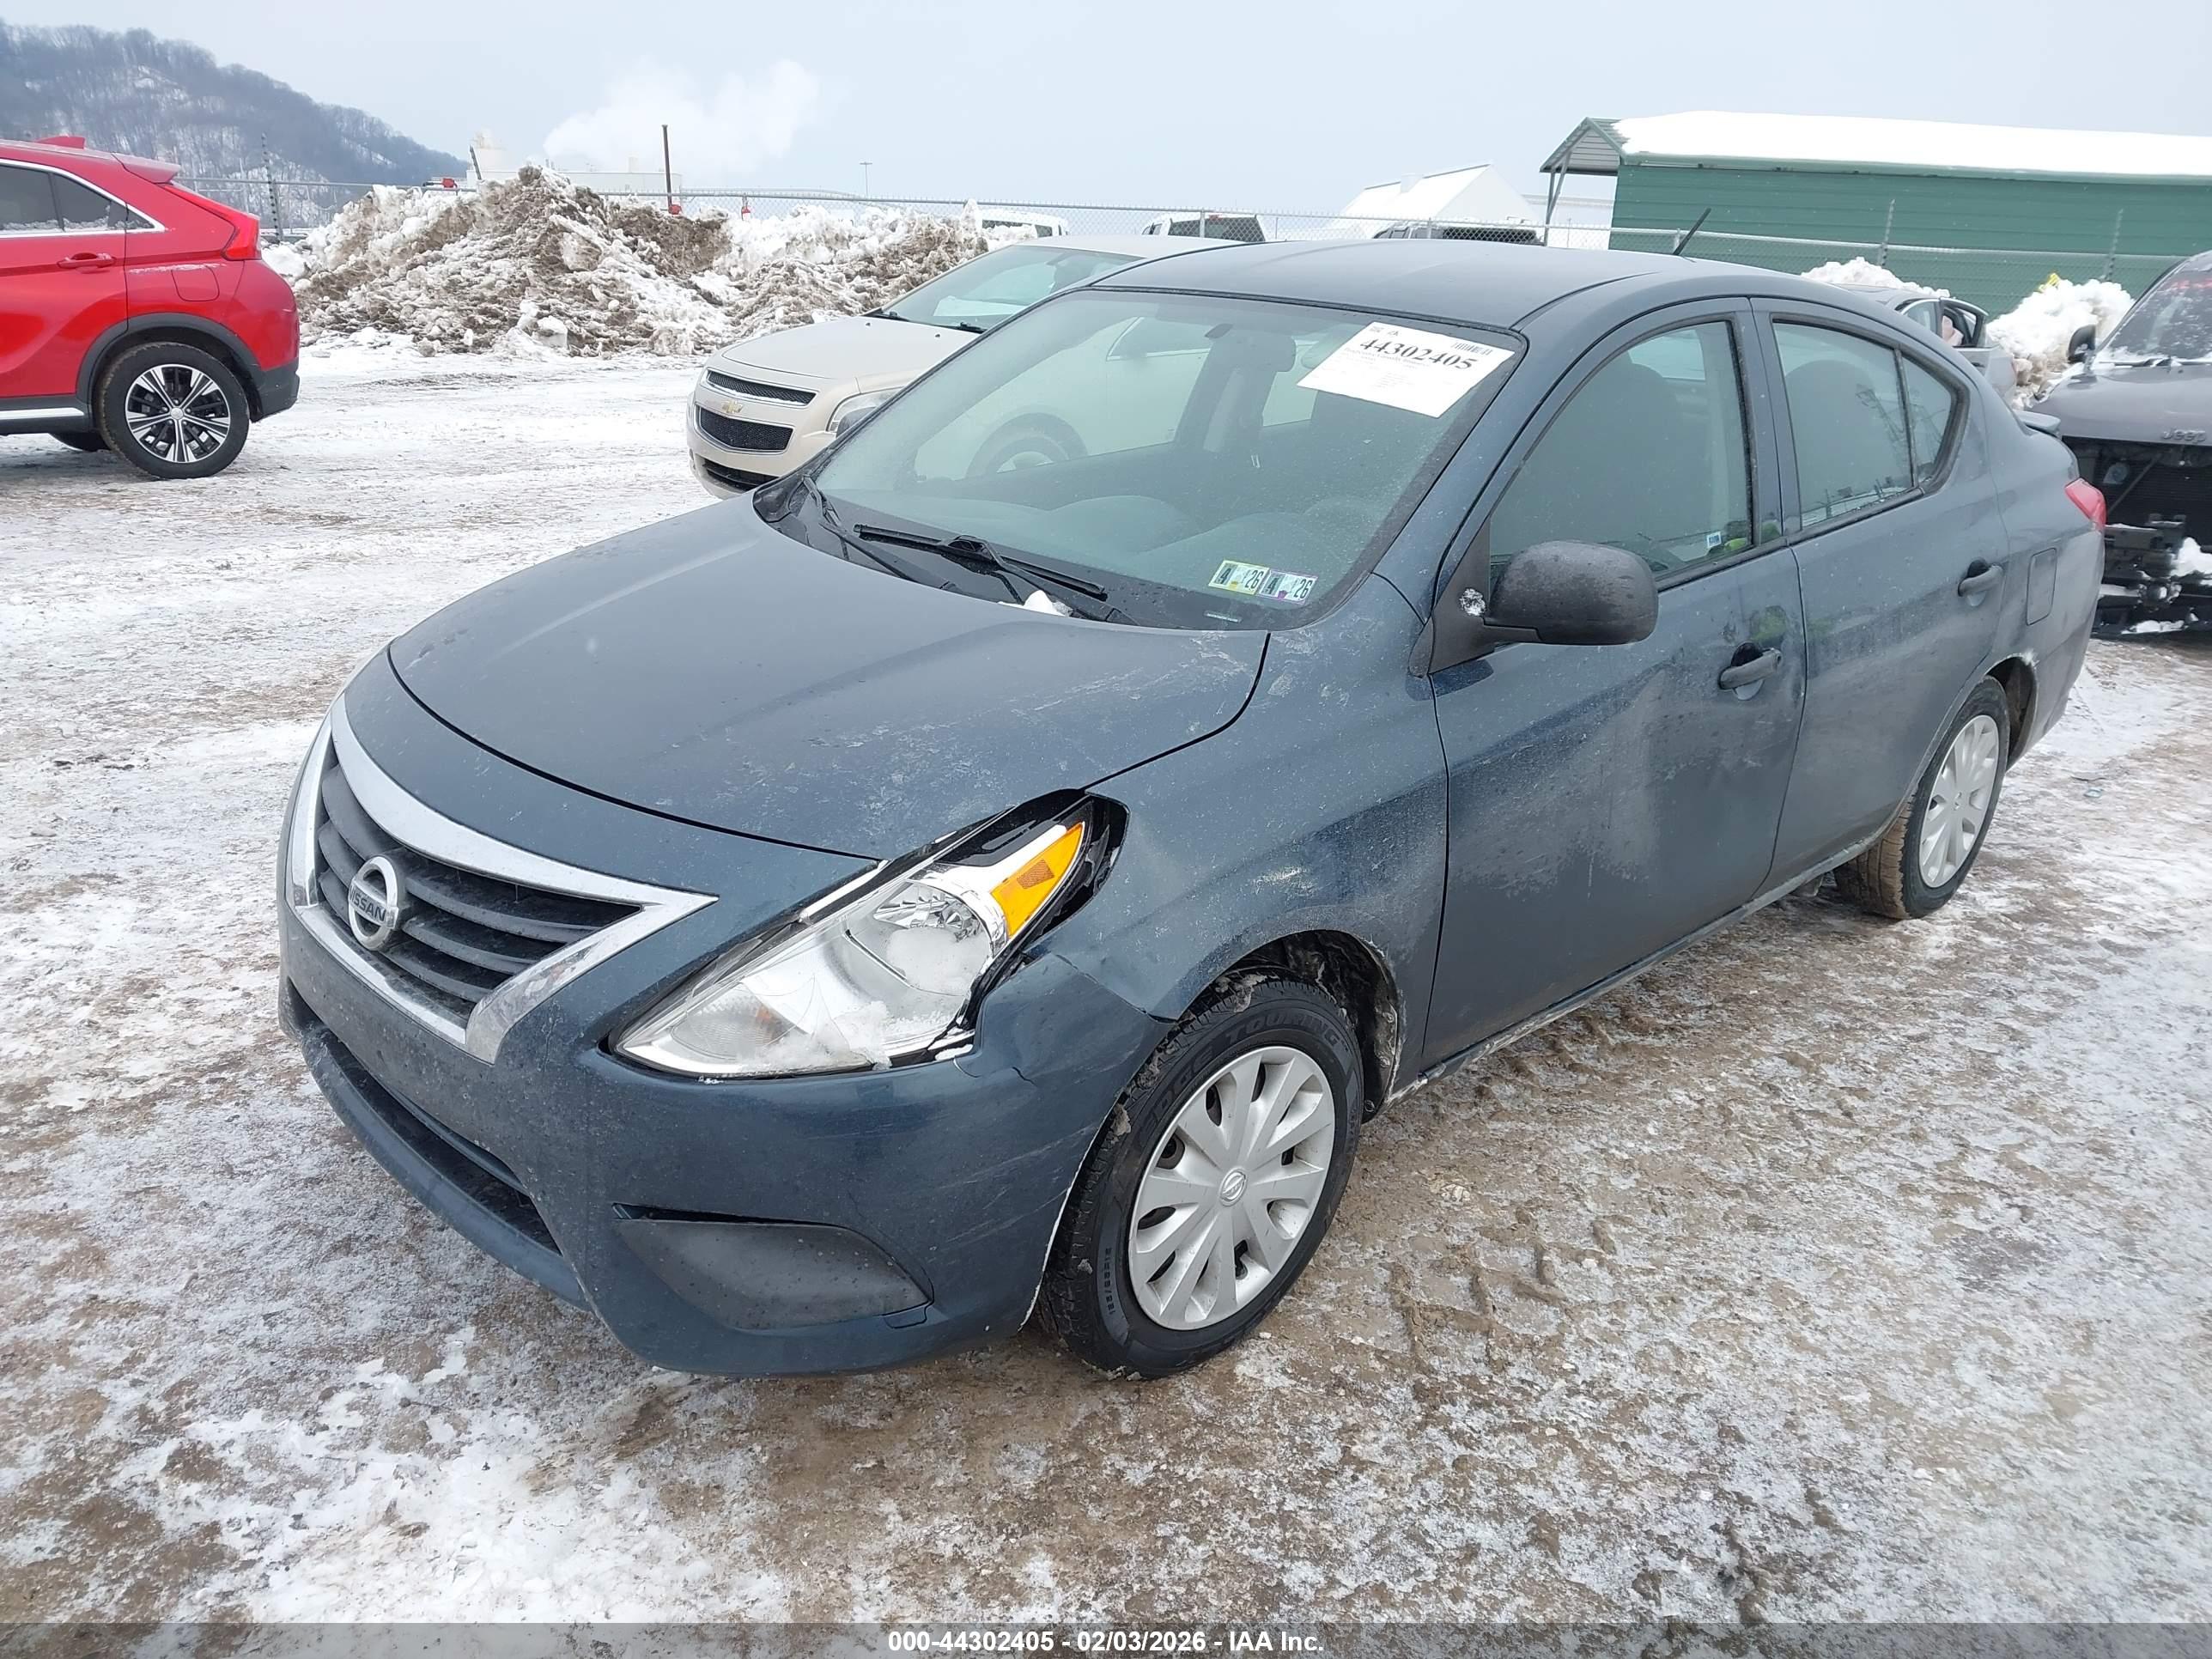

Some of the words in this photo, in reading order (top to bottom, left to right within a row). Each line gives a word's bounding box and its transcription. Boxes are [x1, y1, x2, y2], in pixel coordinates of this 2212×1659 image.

[1359, 338, 1479, 370] 44302405
[2160, 428, 2207, 444] Jeep
[1219, 568, 1231, 585] 4
[1245, 569, 1264, 589] 26
[1267, 577, 1279, 594] 4
[1293, 579, 1313, 599] 26
[350, 884, 386, 921] NISSAN
[1224, 1012, 1341, 1045] TOURING
